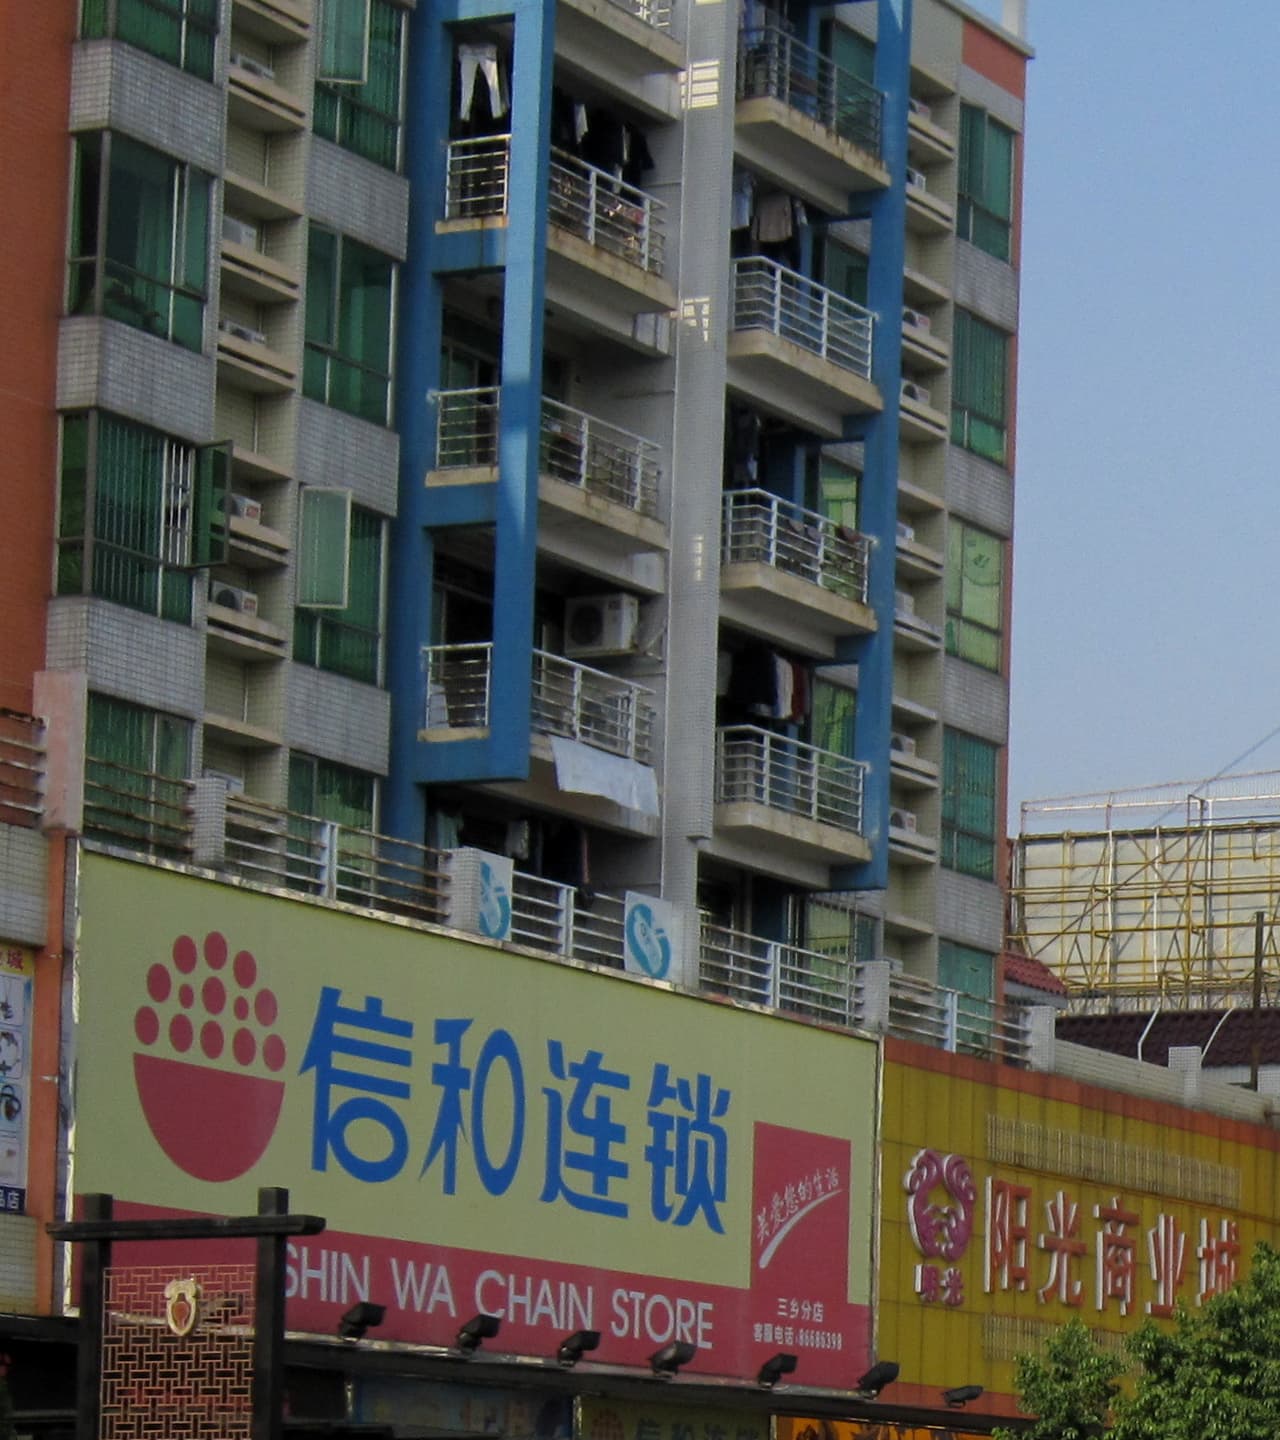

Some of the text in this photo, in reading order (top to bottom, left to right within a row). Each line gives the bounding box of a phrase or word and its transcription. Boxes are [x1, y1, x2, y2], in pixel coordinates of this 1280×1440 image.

[299, 986, 731, 1236] 信和连锁
[285, 1244, 713, 1349] SHIN WA CHAIN STORE
[983, 1176, 1241, 1318] 阳光商业城
[777, 1298, 824, 1322] 三乡分店
